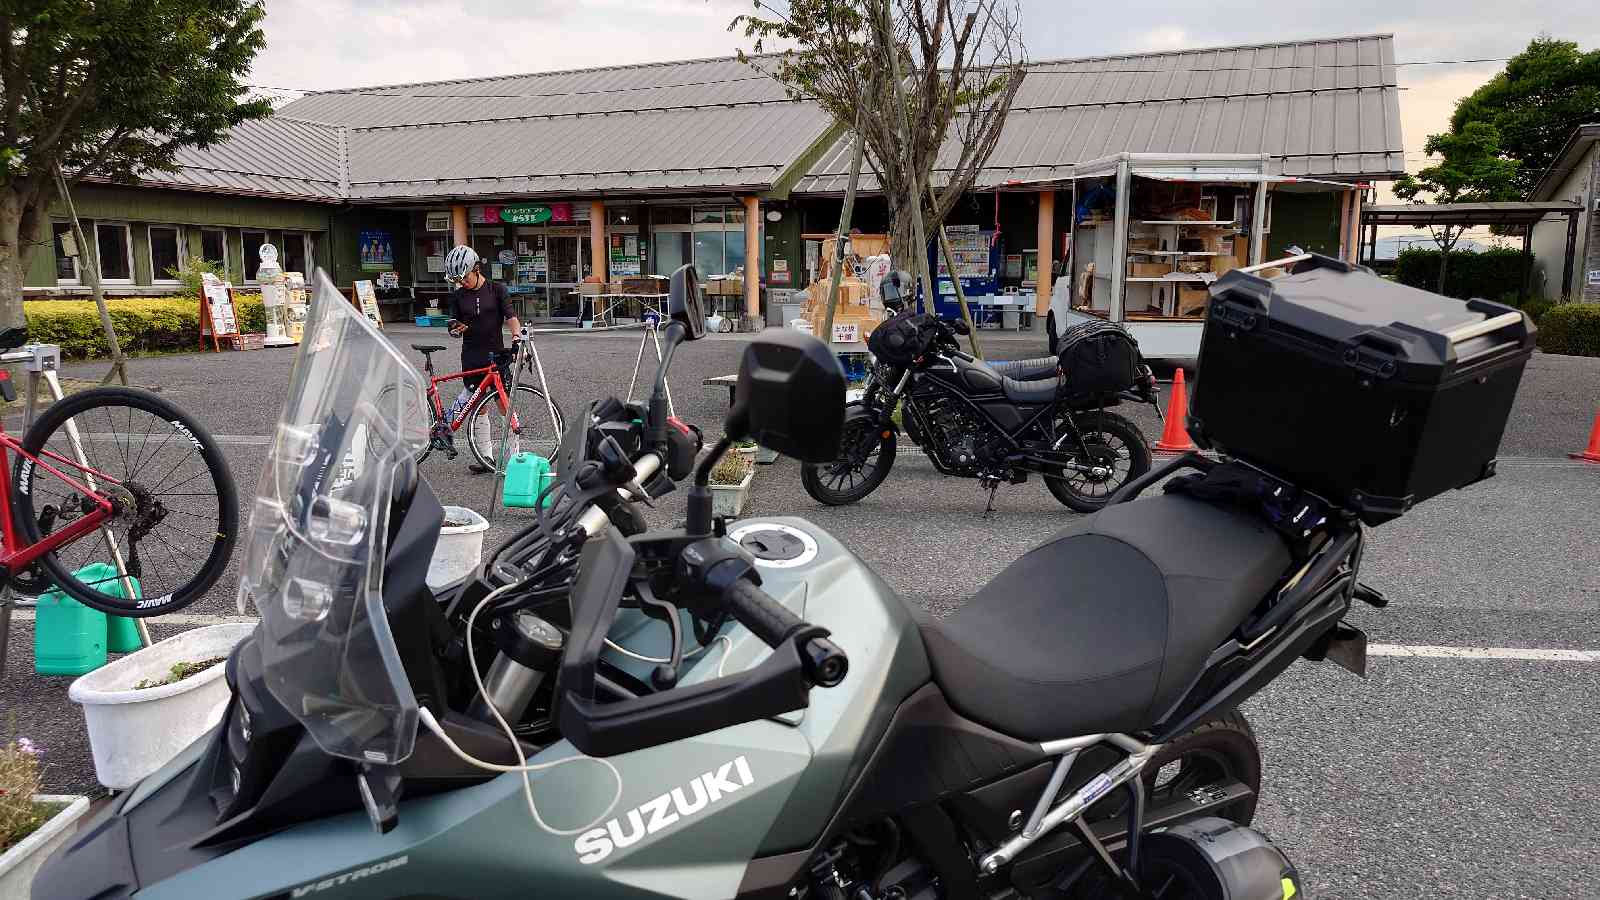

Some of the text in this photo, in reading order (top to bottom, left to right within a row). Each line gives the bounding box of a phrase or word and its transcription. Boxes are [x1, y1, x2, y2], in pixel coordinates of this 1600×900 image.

[171, 420, 205, 450] MAVIC
[136, 593, 173, 609] MAVIC
[574, 755, 755, 864] SUZUKI
